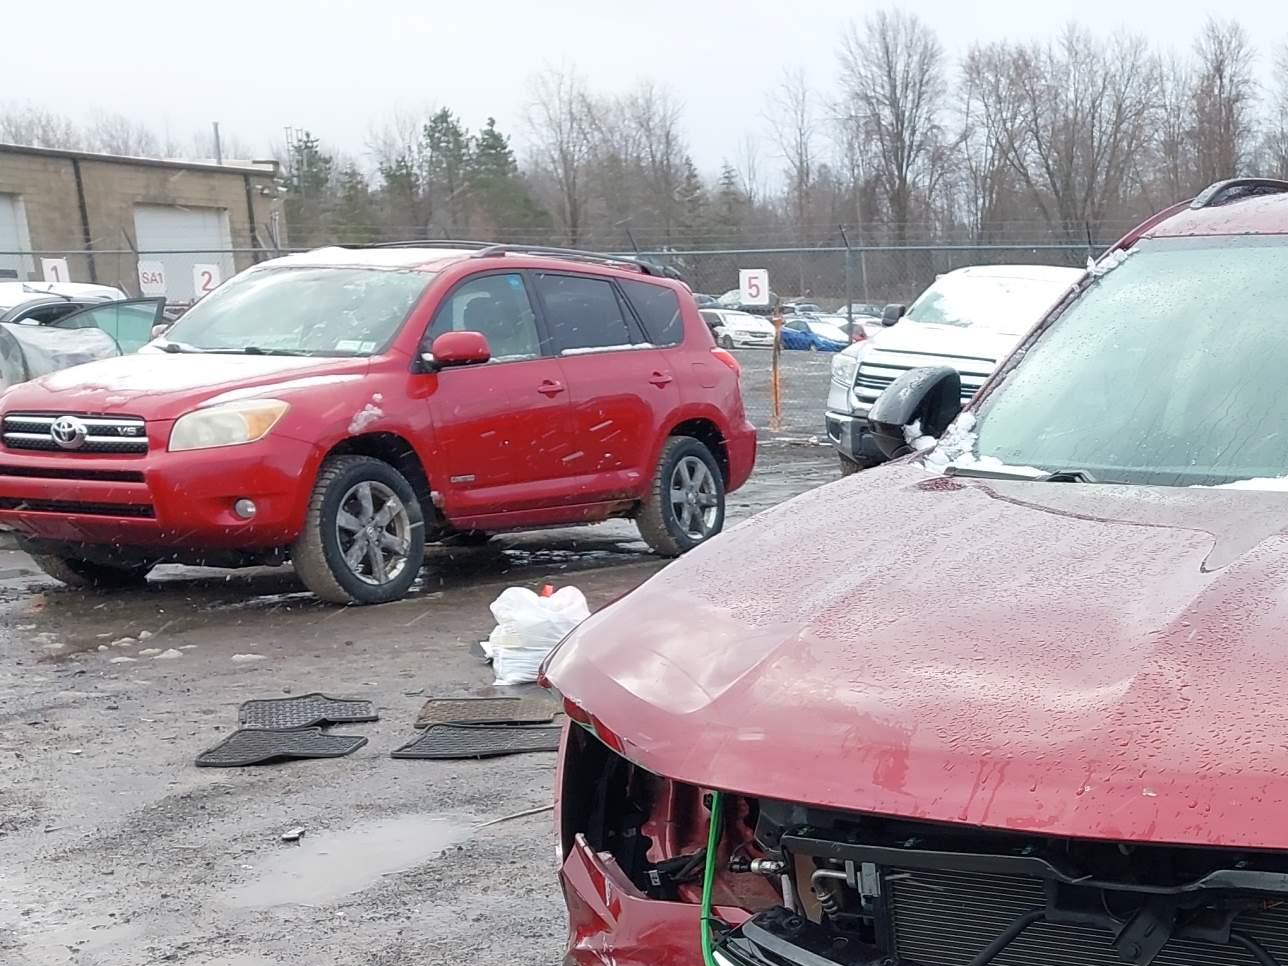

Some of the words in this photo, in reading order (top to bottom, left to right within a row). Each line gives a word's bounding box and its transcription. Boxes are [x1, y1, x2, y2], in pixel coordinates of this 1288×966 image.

[50, 265, 60, 282] 1
[141, 271, 164, 284] SA1
[201, 271, 213, 291] 2
[747, 276, 760, 298] 5
